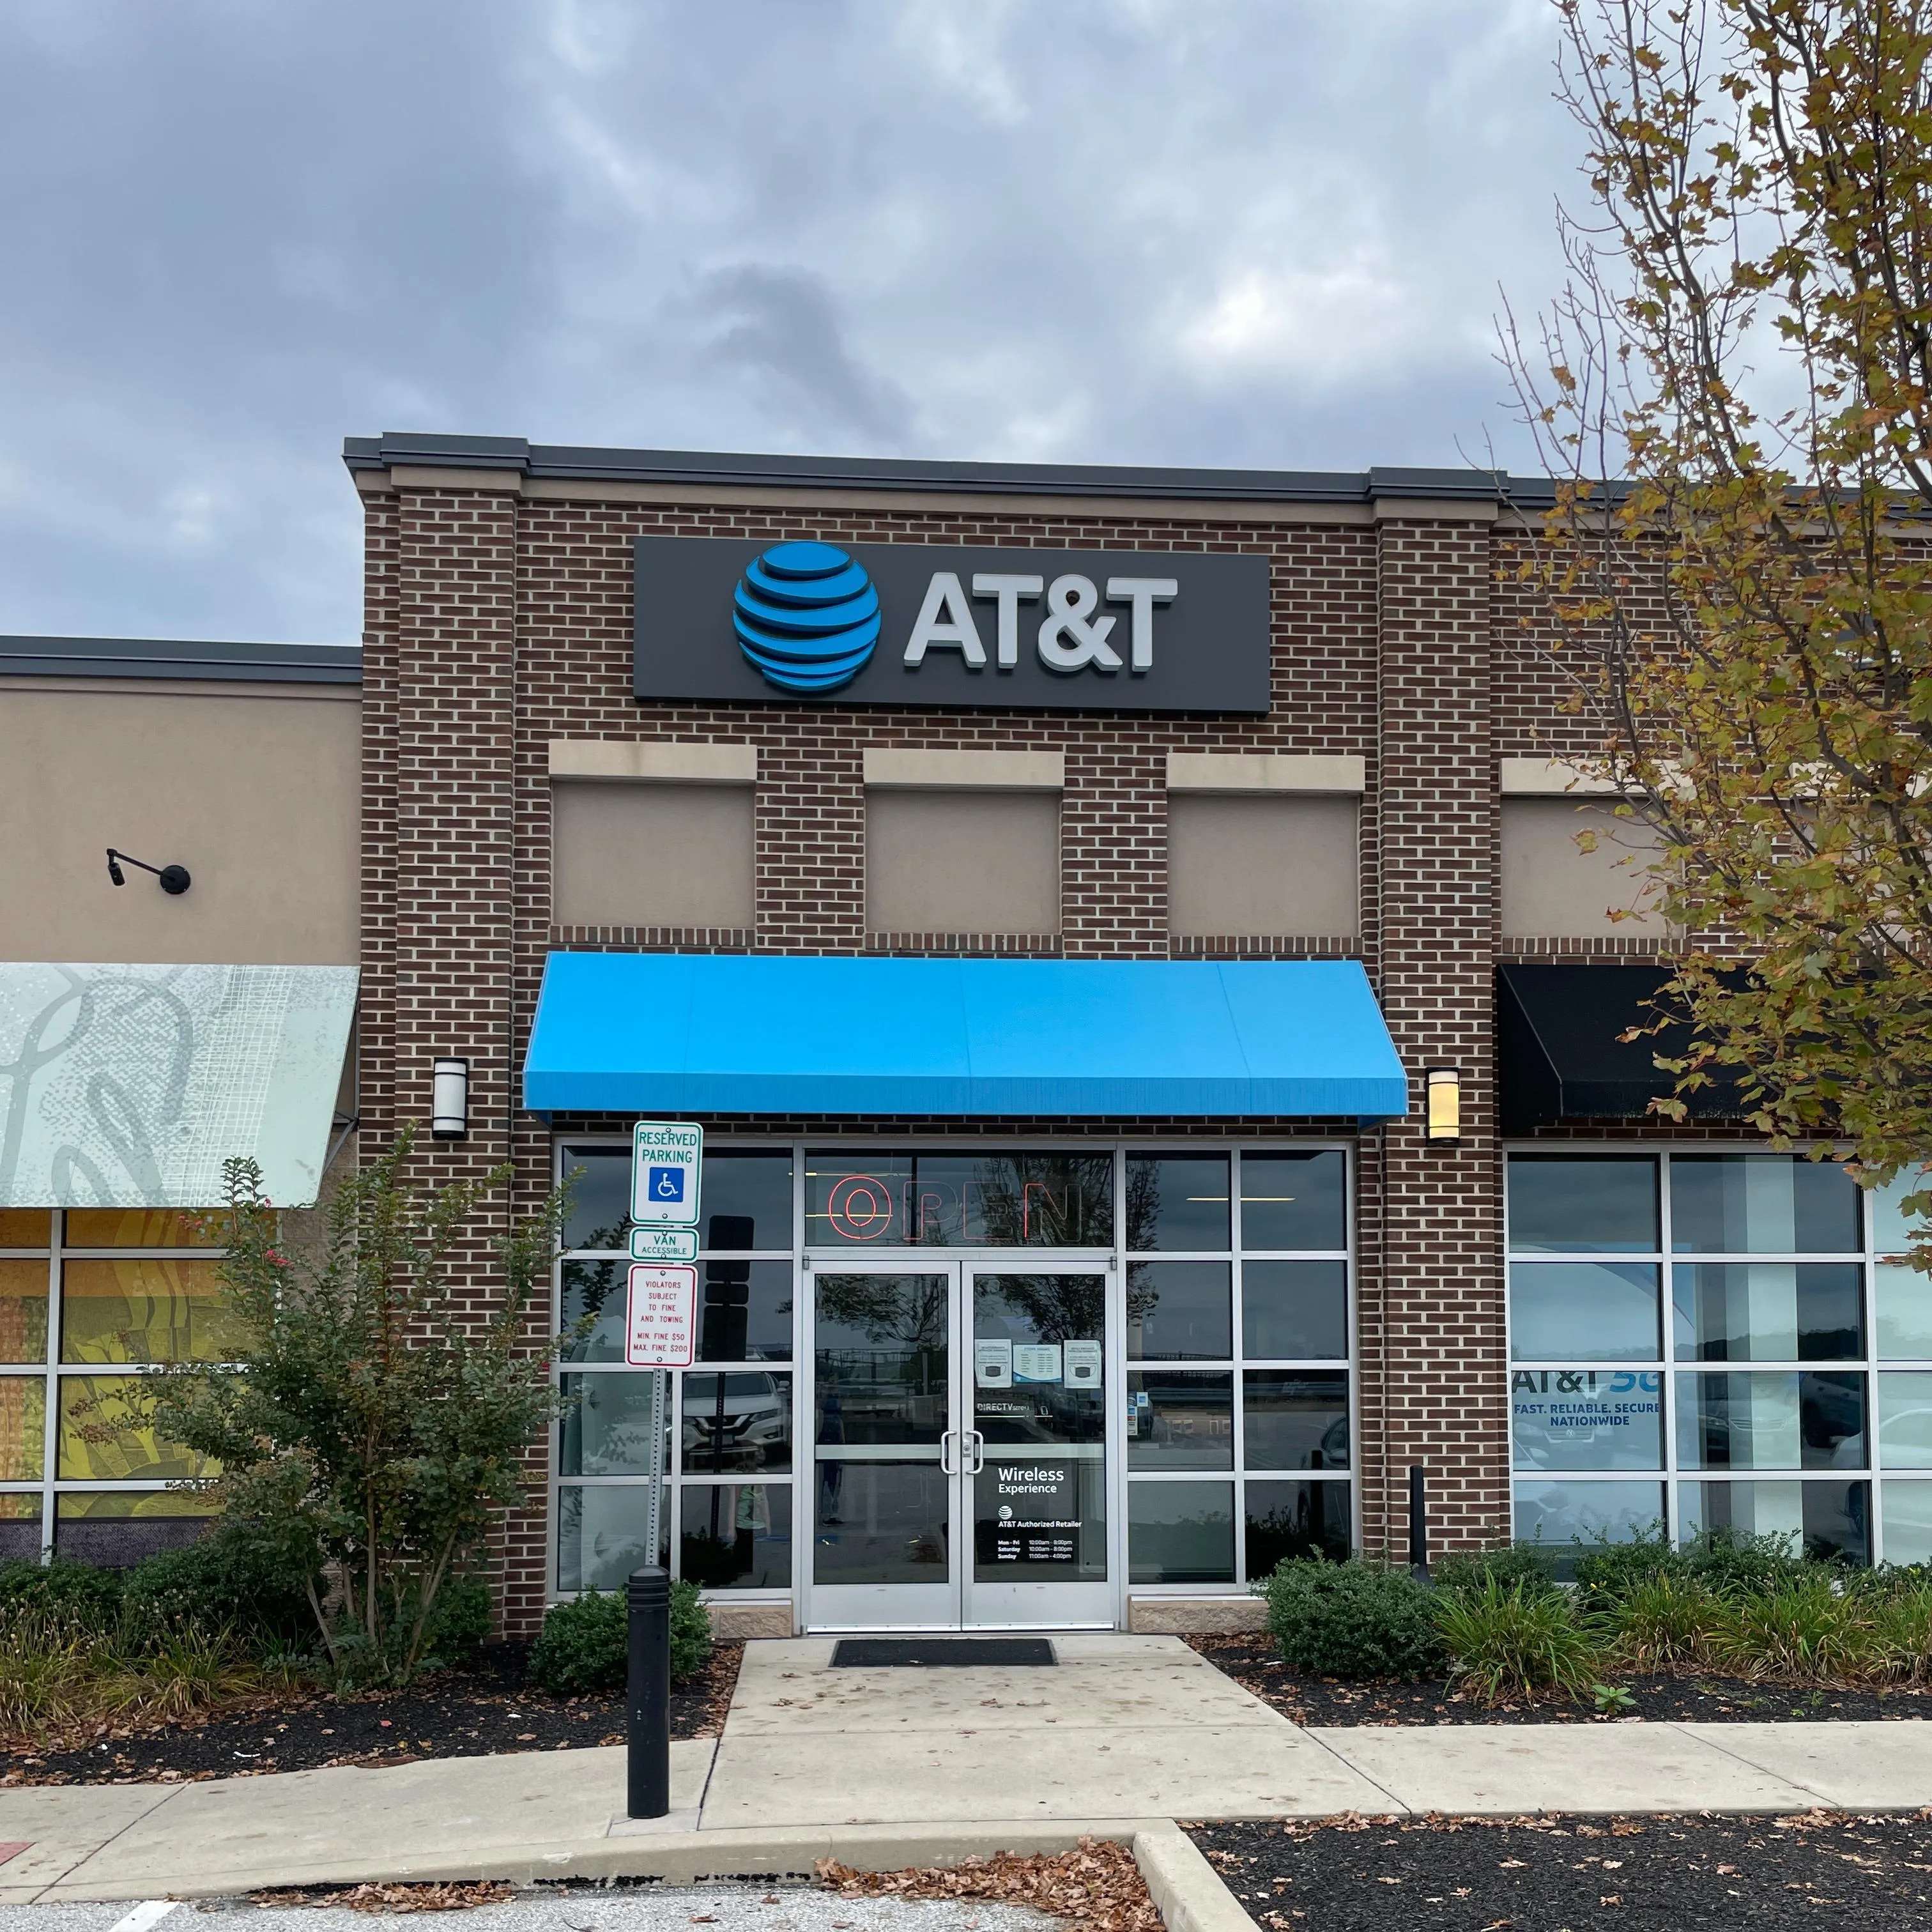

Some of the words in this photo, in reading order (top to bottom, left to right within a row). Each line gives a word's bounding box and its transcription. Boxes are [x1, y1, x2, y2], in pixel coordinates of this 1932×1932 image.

[903, 572, 1179, 673] AT&T
[639, 1131, 696, 1147] RESERVED
[641, 1149, 693, 1164] PARKING
[828, 1175, 1082, 1242] OPEN
[654, 1235, 676, 1246] VAN
[641, 1246, 687, 1255] ACCESSIBLE
[645, 1280, 681, 1289] VIOLATORS
[648, 1292, 677, 1301] SUBJECT
[640, 1315, 654, 1323] AND
[659, 1315, 683, 1324] TOWING
[672, 1333, 685, 1341] $50
[670, 1345, 688, 1353] $200
[977, 1402, 1013, 1411] DIRECTV
[1514, 1404, 1547, 1414] FAST.
[1550, 1404, 1611, 1414] RELIABLE.
[1550, 1416, 1630, 1426] NATIONWIDE
[998, 1467, 1064, 1482] Wireless
[998, 1483, 1057, 1496] Experience
